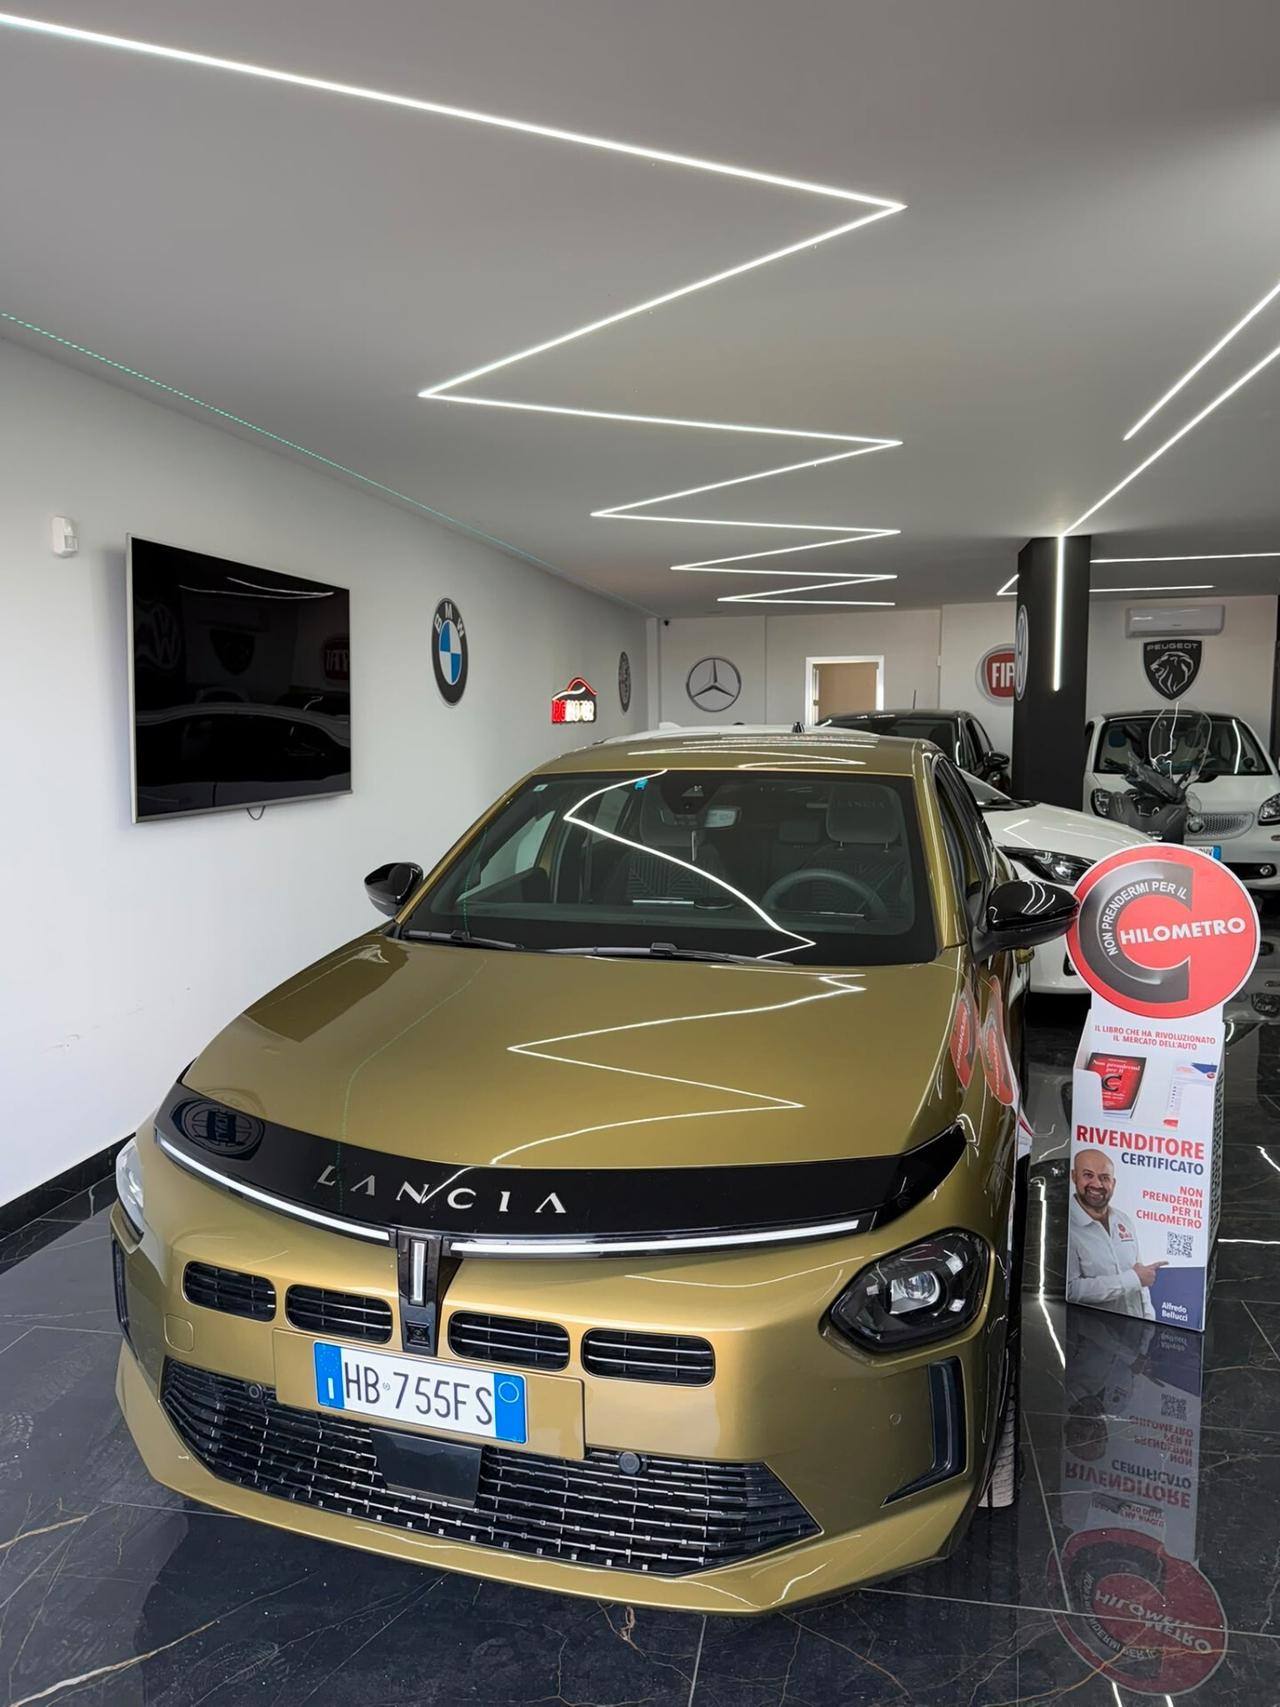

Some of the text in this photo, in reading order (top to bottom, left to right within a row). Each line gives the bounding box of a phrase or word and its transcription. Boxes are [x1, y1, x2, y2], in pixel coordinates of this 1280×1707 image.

[434, 602, 465, 638] BMW
[1146, 642, 1198, 651] PEUGEOT
[992, 662, 1015, 689] FIA
[1102, 881, 1187, 956] NON PRENDERMI PER IL
[1102, 1026, 1124, 1034] LIBRO
[1125, 1028, 1141, 1036] CHE
[1155, 1031, 1216, 1045] RIVOLUZIONATO
[1122, 1036, 1157, 1046] MERCATO
[1159, 1039, 1197, 1050] DELL'AUTO
[1076, 1124, 1205, 1160] RIVENDITORE
[1121, 1152, 1204, 1175] CERTIFICATO
[316, 1165, 567, 1214] LANCIA
[1180, 1186, 1203, 1198] NON
[1142, 1190, 1203, 1209] PRENDERMI
[1136, 1209, 1202, 1229] CHILOMETRO
[1172, 1206, 1203, 1219] PER IL
[1161, 1302, 1187, 1314] Alfredo
[1161, 1310, 1188, 1322] Bellucci
